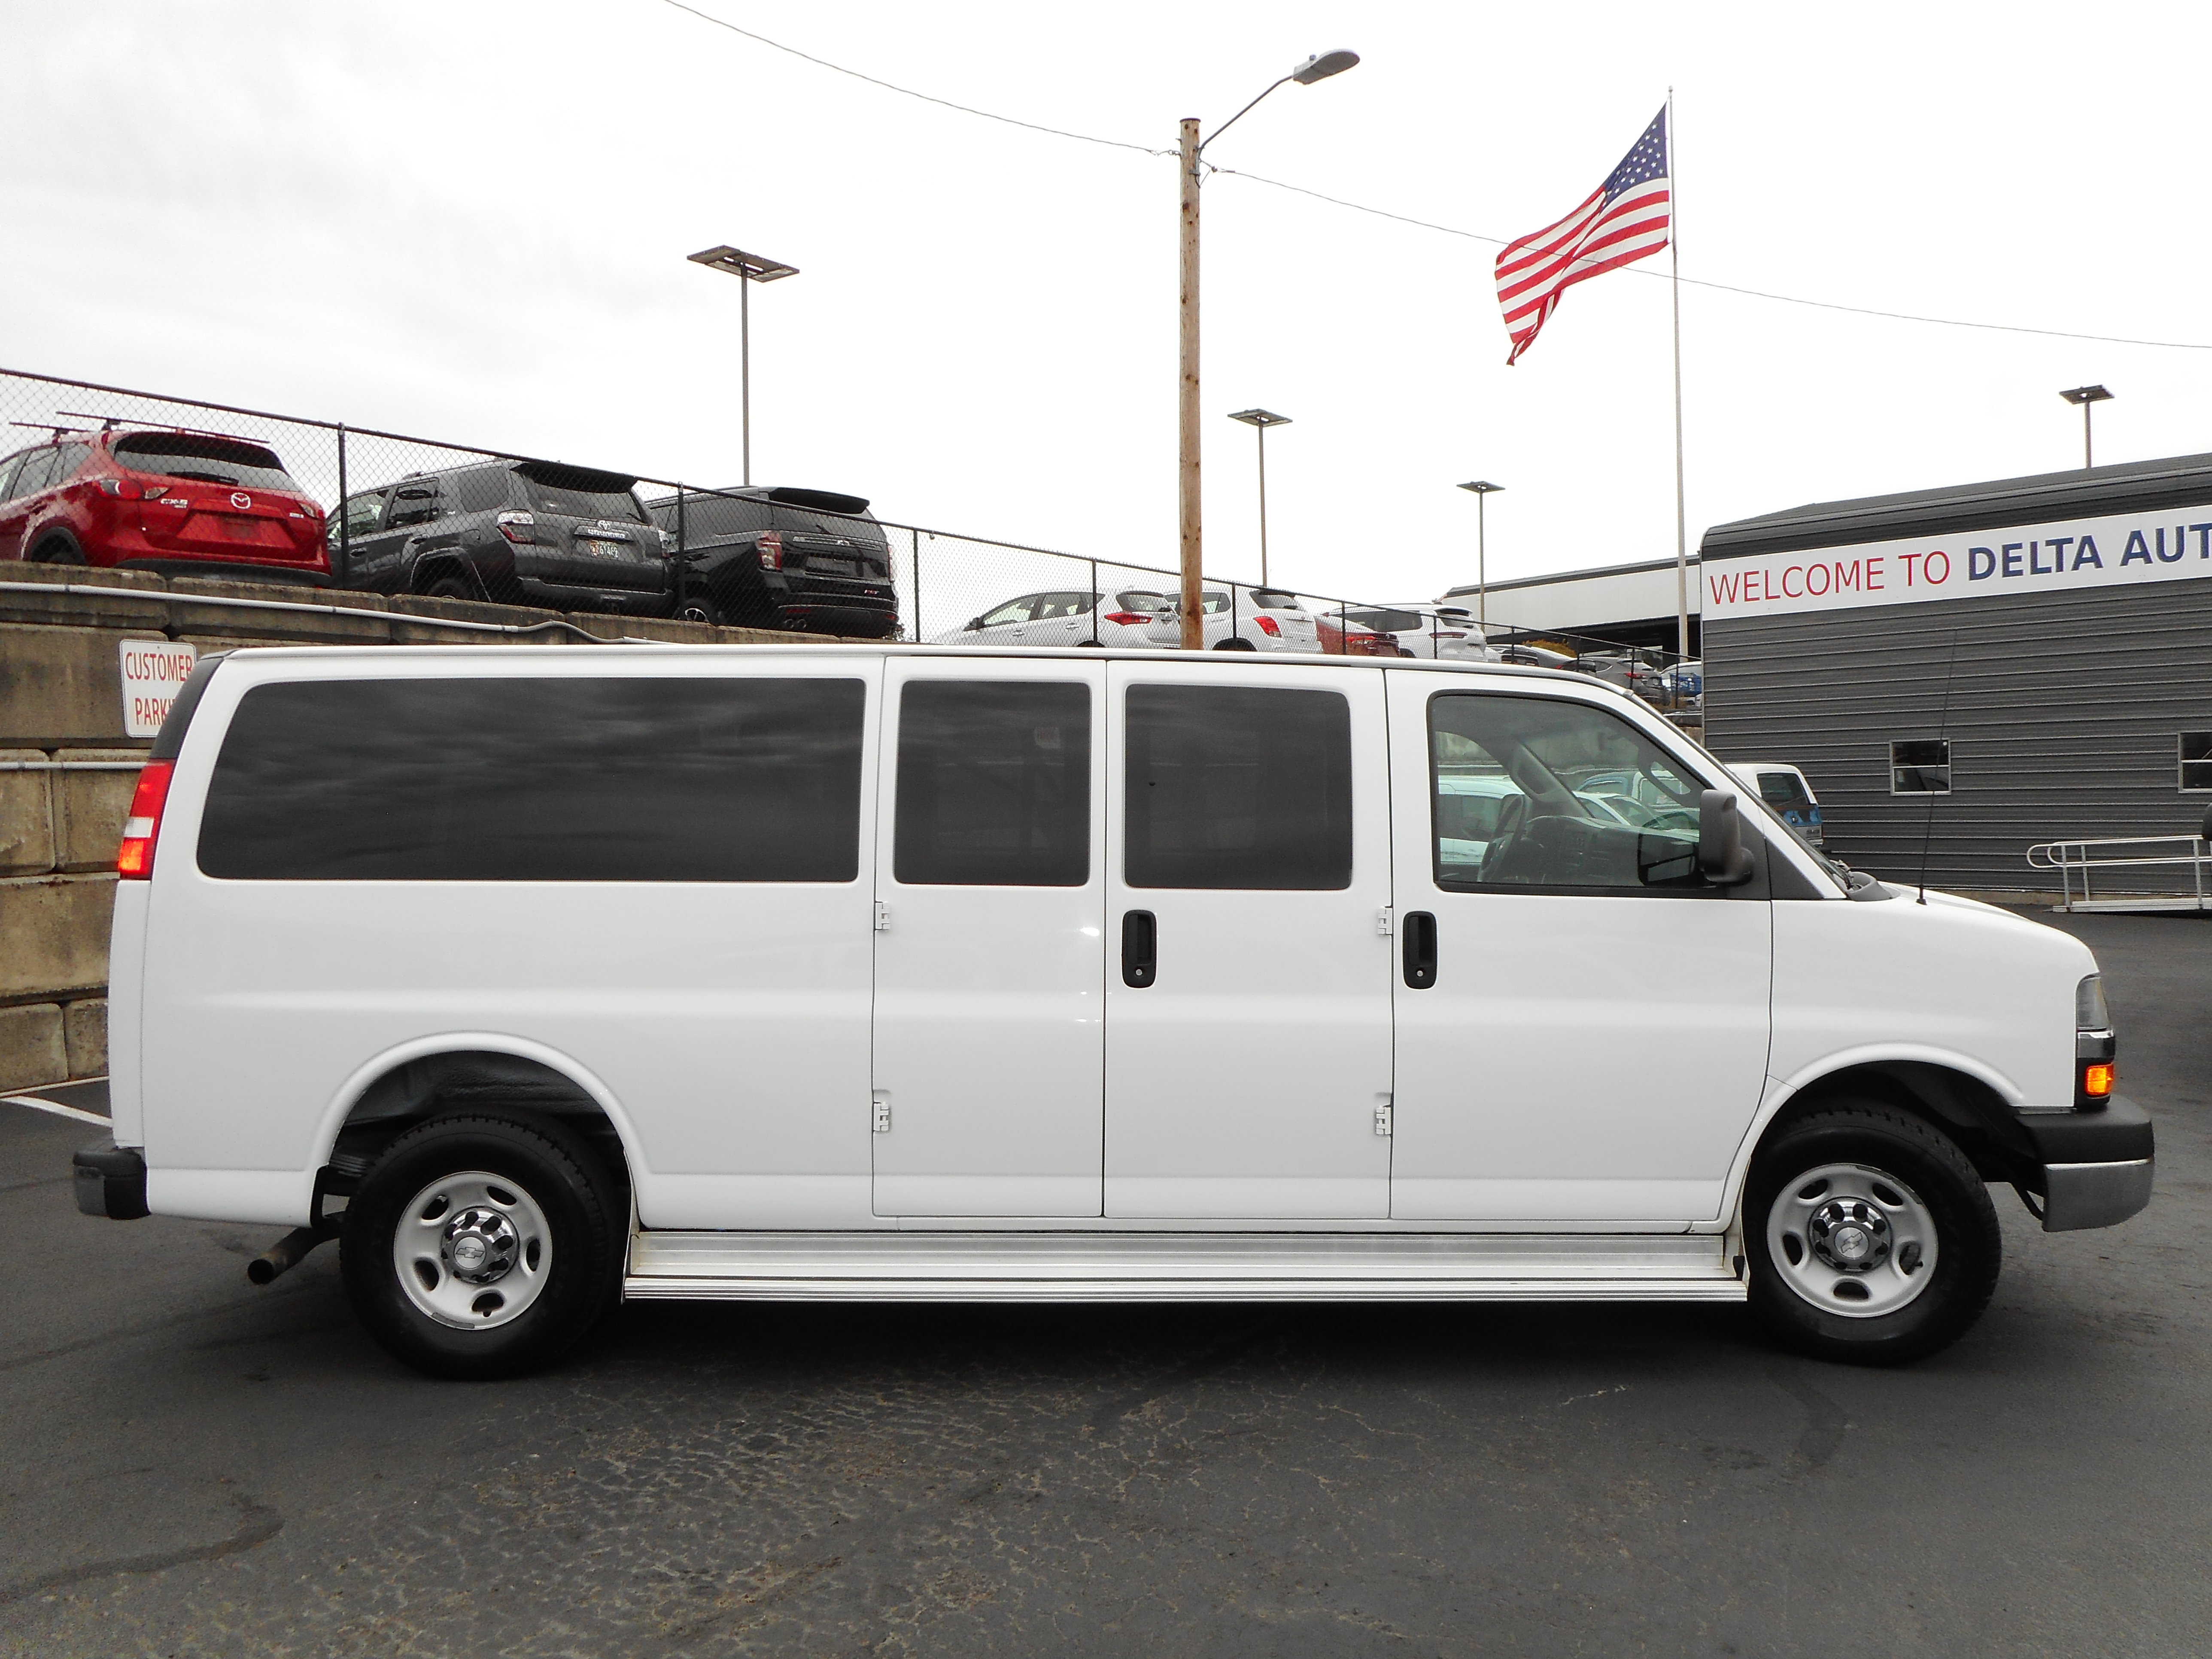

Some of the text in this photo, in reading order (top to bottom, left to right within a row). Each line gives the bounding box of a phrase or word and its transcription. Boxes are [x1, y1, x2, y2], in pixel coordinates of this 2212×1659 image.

[1709, 523, 2212, 605] WELCOME TO DELTA AUT
[125, 652, 193, 682] CUSTOMER
[135, 697, 176, 725] PARK
